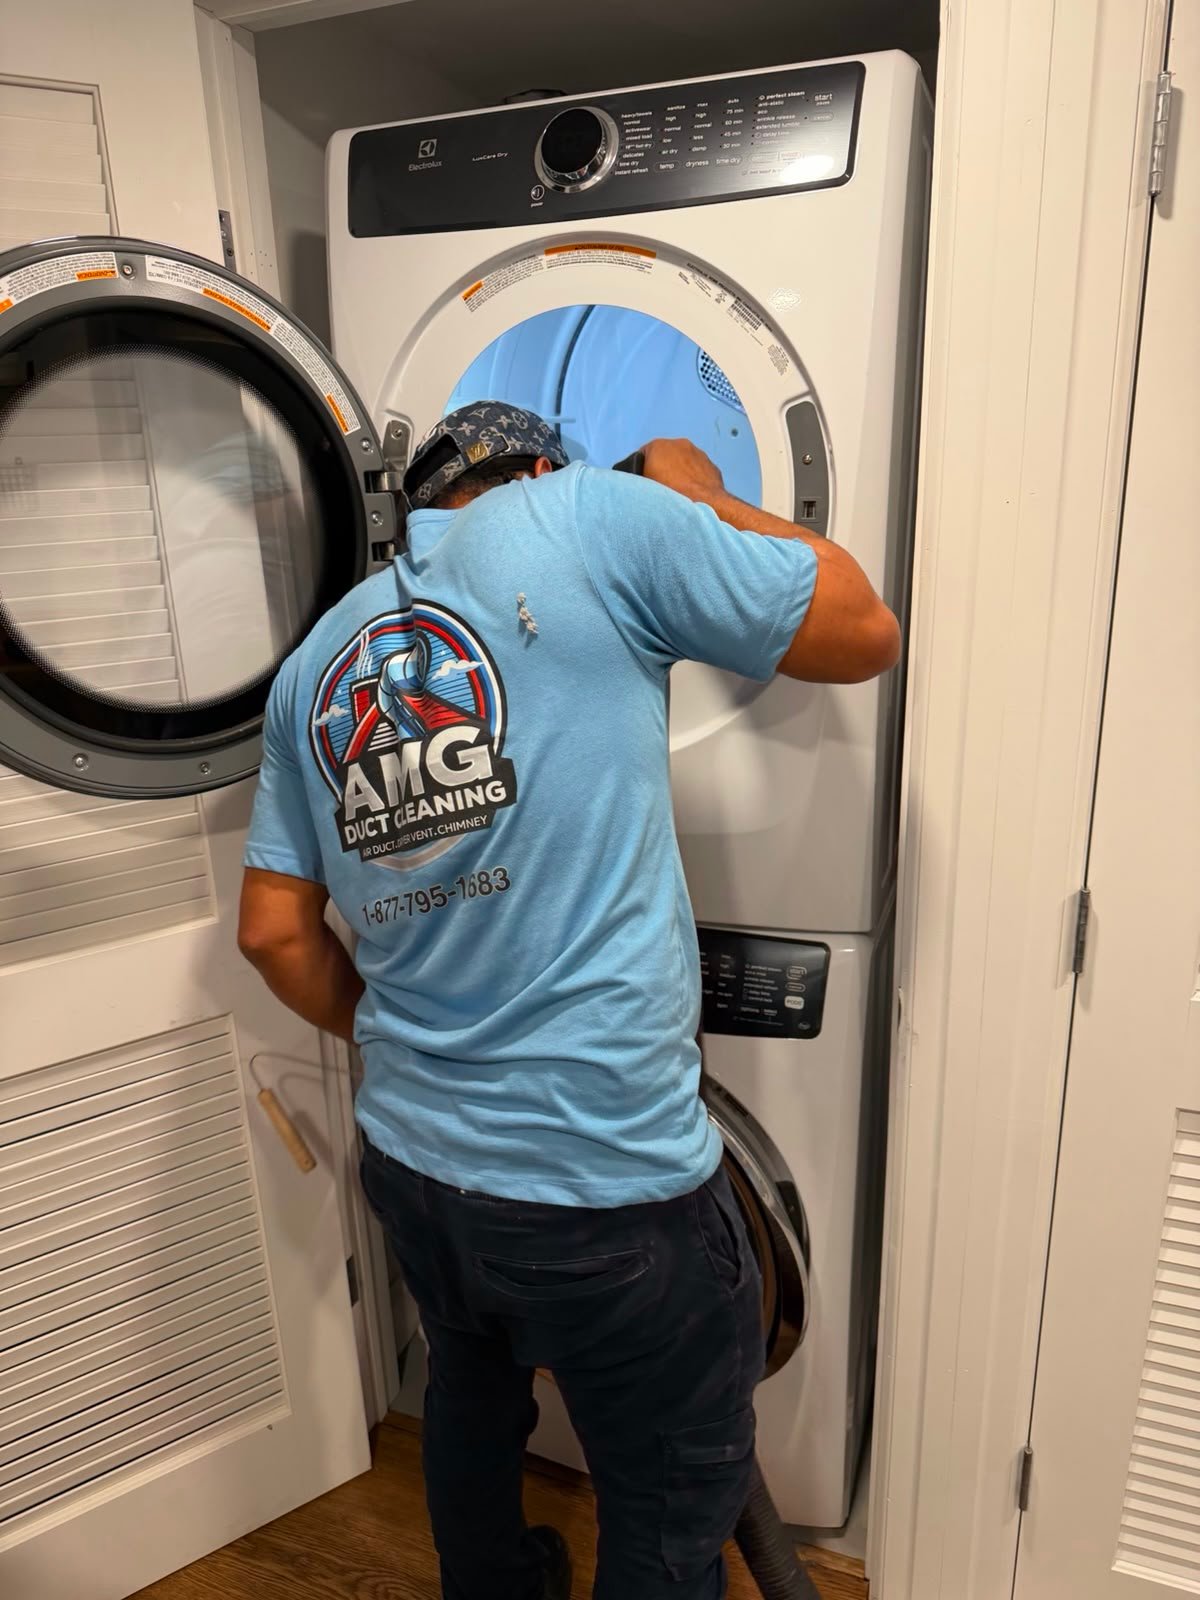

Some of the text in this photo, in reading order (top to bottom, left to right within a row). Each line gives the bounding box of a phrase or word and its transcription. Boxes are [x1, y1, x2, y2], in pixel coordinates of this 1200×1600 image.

[409, 160, 442, 171] Electrolux
[344, 725, 493, 822] AMG
[344, 780, 508, 846] DUCT CLEANING
[362, 867, 512, 928] 1-877-795-1683
